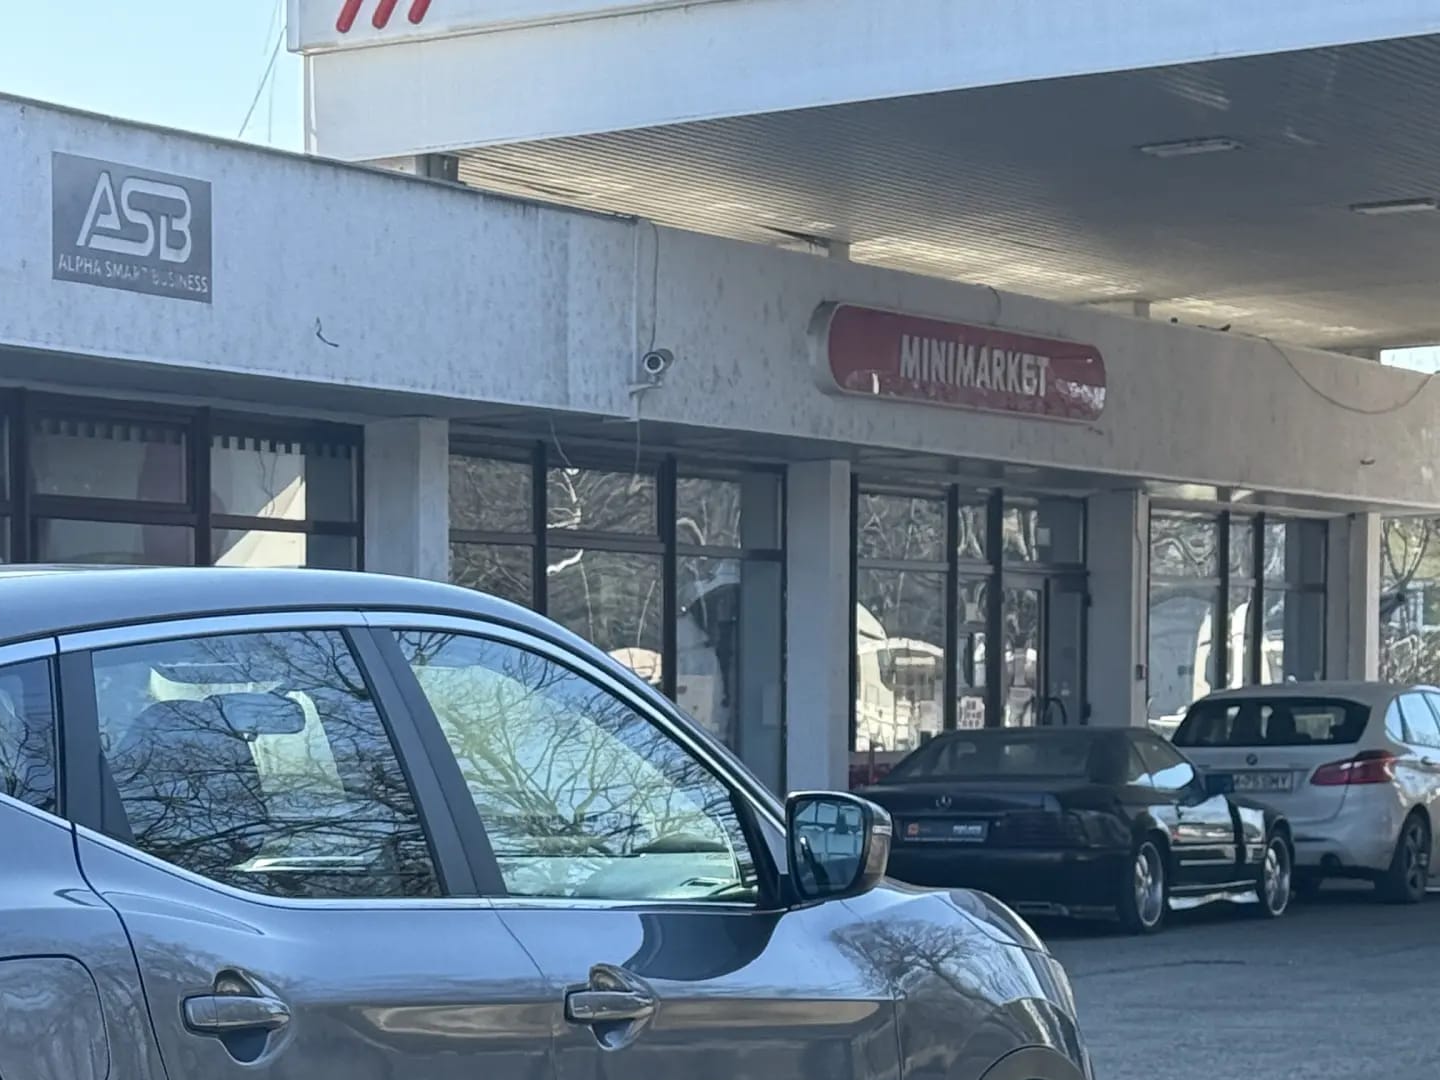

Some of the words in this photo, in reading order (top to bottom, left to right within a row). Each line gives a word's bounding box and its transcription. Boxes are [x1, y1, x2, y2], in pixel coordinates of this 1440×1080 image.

[76, 171, 192, 264] ASB
[58, 254, 102, 276] ALPHA
[152, 268, 209, 292] BSNESS
[900, 334, 1051, 398] MINIMARKET
